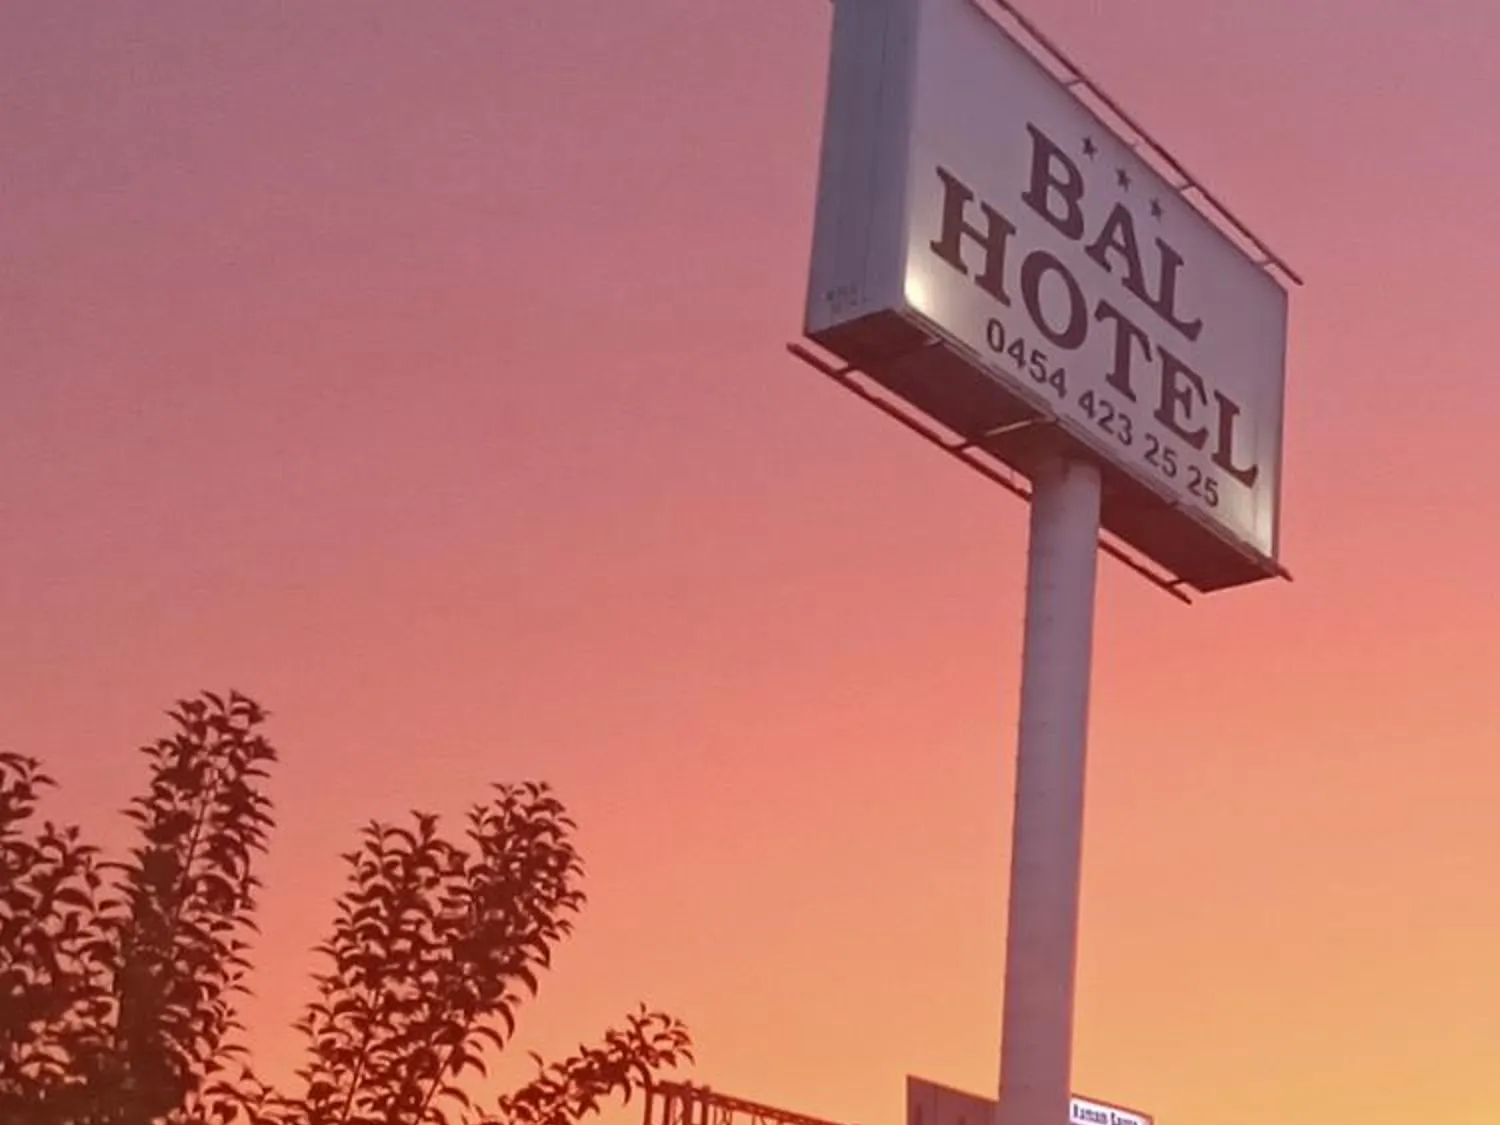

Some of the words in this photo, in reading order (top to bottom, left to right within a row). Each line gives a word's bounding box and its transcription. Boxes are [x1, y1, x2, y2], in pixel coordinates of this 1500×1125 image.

[929, 166, 1259, 487] HOTEL
[1021, 122, 1203, 341] BAL
[986, 318, 1067, 398] 0454
[1079, 391, 1133, 447] 423
[1144, 434, 1177, 476] 25
[1188, 465, 1219, 507] 25
